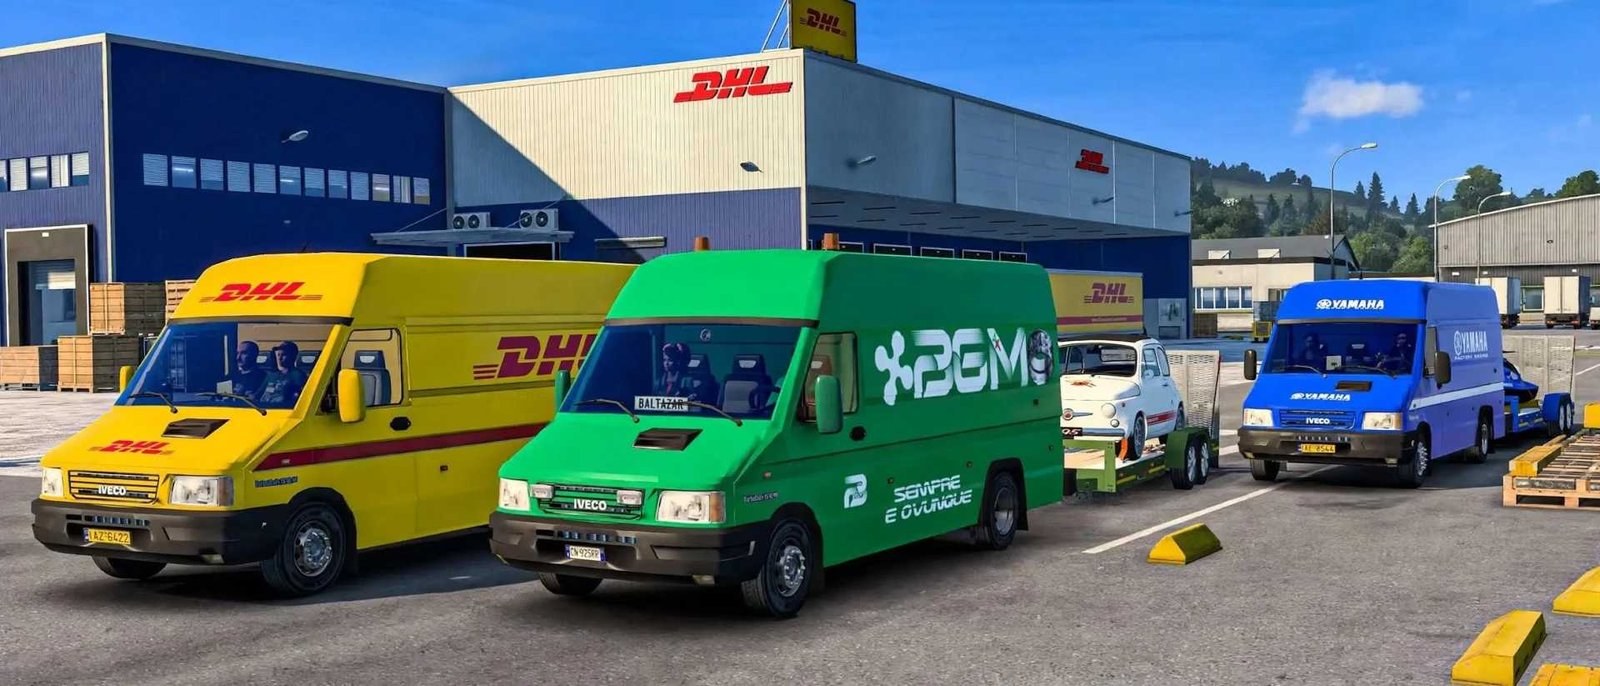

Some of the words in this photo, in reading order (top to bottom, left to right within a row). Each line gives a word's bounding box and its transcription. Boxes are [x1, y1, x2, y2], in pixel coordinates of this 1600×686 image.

[801, 8, 847, 36] DHL
[673, 66, 793, 103] DHL
[200, 281, 322, 302] DHL
[1085, 283, 1134, 303] DHL
[1331, 299, 1384, 310] YAMAHA
[1461, 331, 1488, 353] YAMAHA
[912, 327, 1029, 399] BGM
[638, 397, 685, 410] BALTAZAR
[1304, 393, 1351, 401] YAMAHA
[92, 439, 174, 455] DHL
[98, 485, 127, 496] IVECO
[894, 474, 961, 503] SEMPRE
[573, 498, 608, 511] IVECO
[885, 507, 897, 524] E
[900, 489, 973, 520] OVUNQUE
